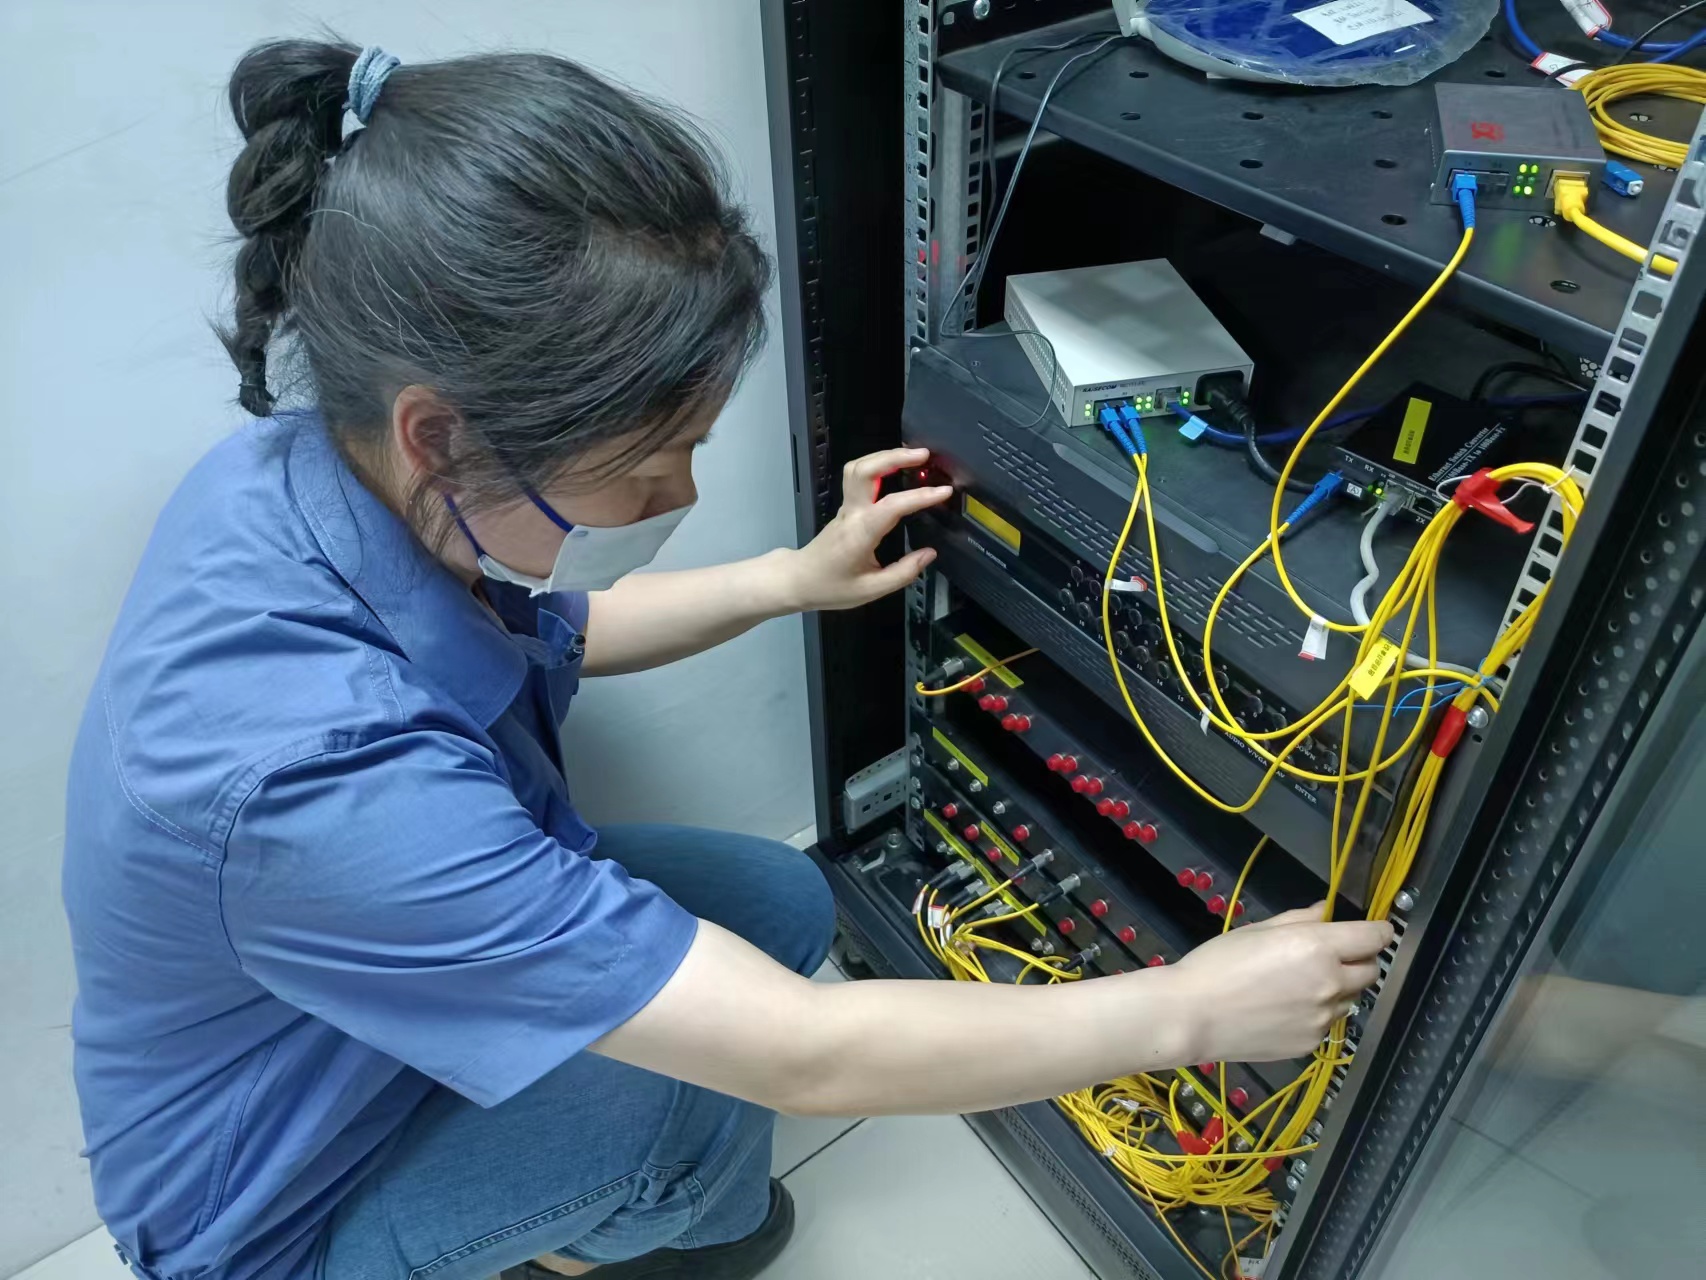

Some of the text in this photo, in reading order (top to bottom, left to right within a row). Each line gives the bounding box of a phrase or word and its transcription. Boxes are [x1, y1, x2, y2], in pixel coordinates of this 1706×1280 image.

[1345, 455, 1354, 463] TX
[1364, 464, 1375, 473] RX
[1427, 427, 1489, 482] Ethernet Switch Converter
[1224, 731, 1245, 749] AUDIO
[1294, 783, 1317, 804] ENTER
